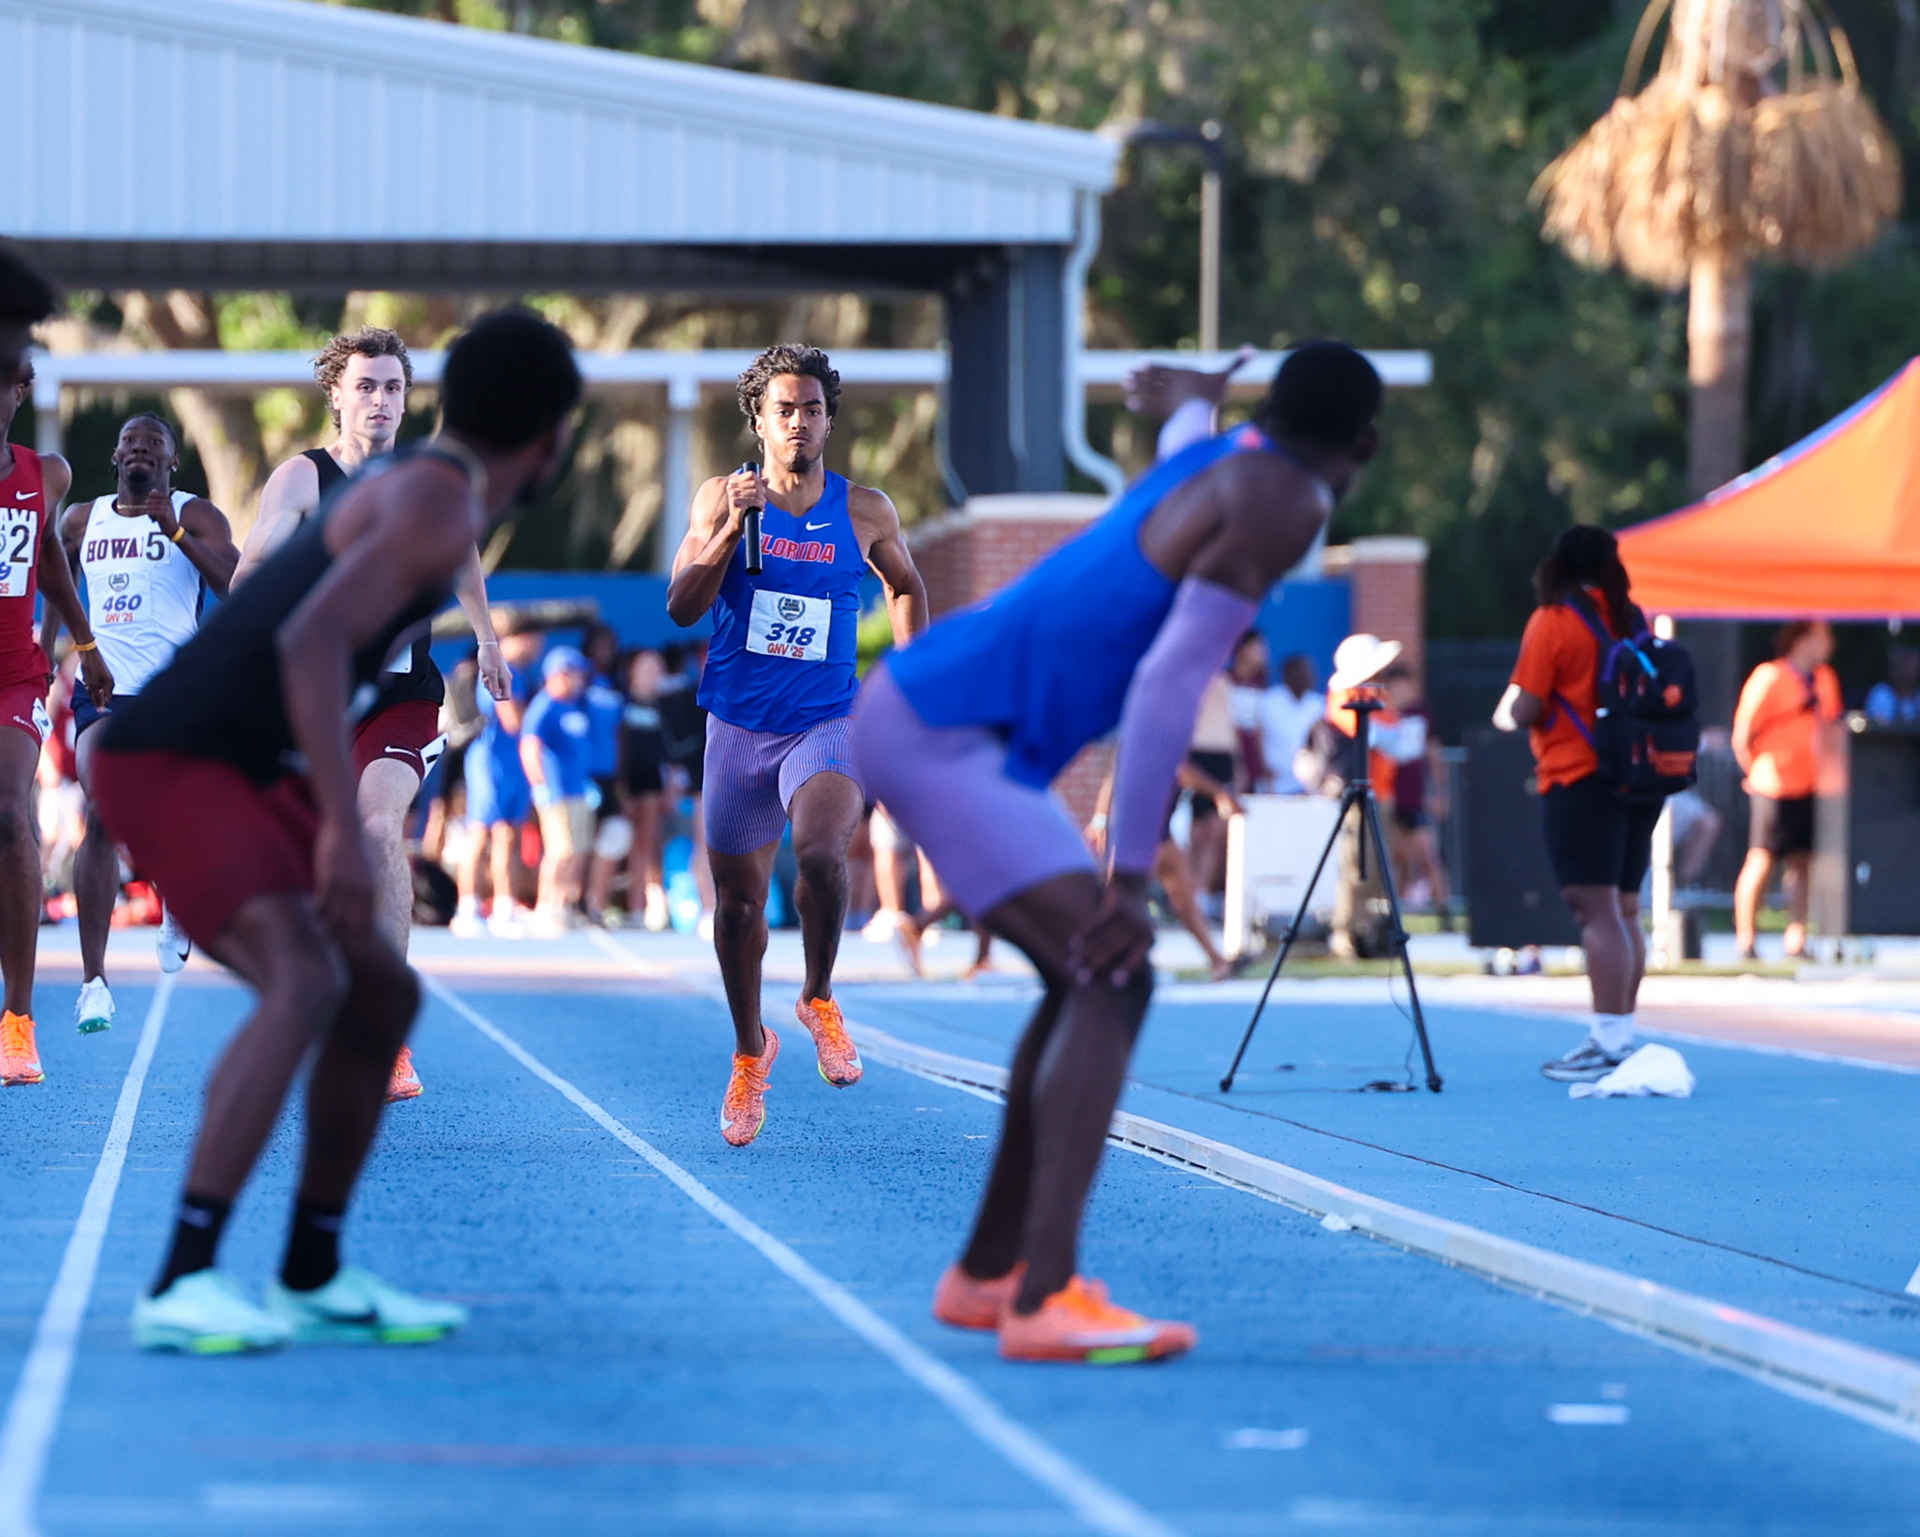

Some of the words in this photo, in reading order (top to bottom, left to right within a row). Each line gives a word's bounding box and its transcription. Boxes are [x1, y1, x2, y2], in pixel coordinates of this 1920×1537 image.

[9, 525, 29, 563] 2
[146, 532, 165, 561] 5
[742, 532, 836, 565] LORIDA
[102, 594, 142, 612] 460
[105, 613, 121, 624] GNV
[765, 623, 816, 646] 318
[767, 643, 790, 656] GNV
[790, 645, 805, 658] '25
